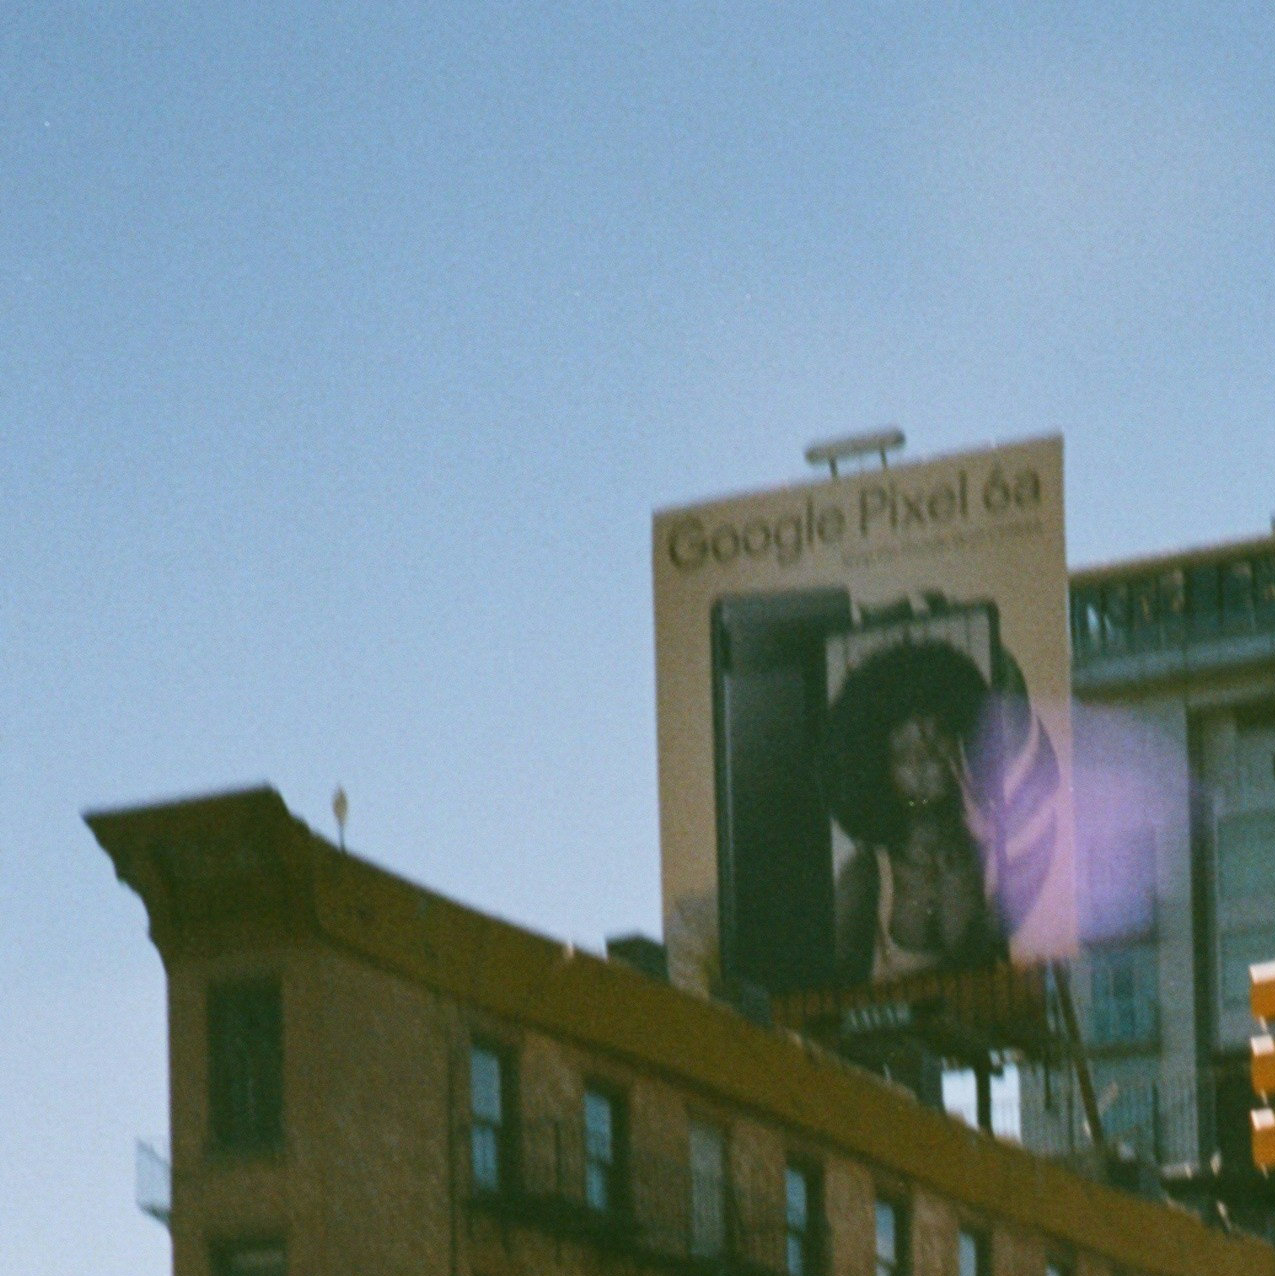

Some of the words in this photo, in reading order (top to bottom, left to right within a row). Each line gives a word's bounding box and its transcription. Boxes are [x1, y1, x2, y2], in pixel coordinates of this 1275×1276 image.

[669, 495, 846, 570] Google
[858, 470, 969, 537] Pixel
[982, 458, 1041, 511] 6a
